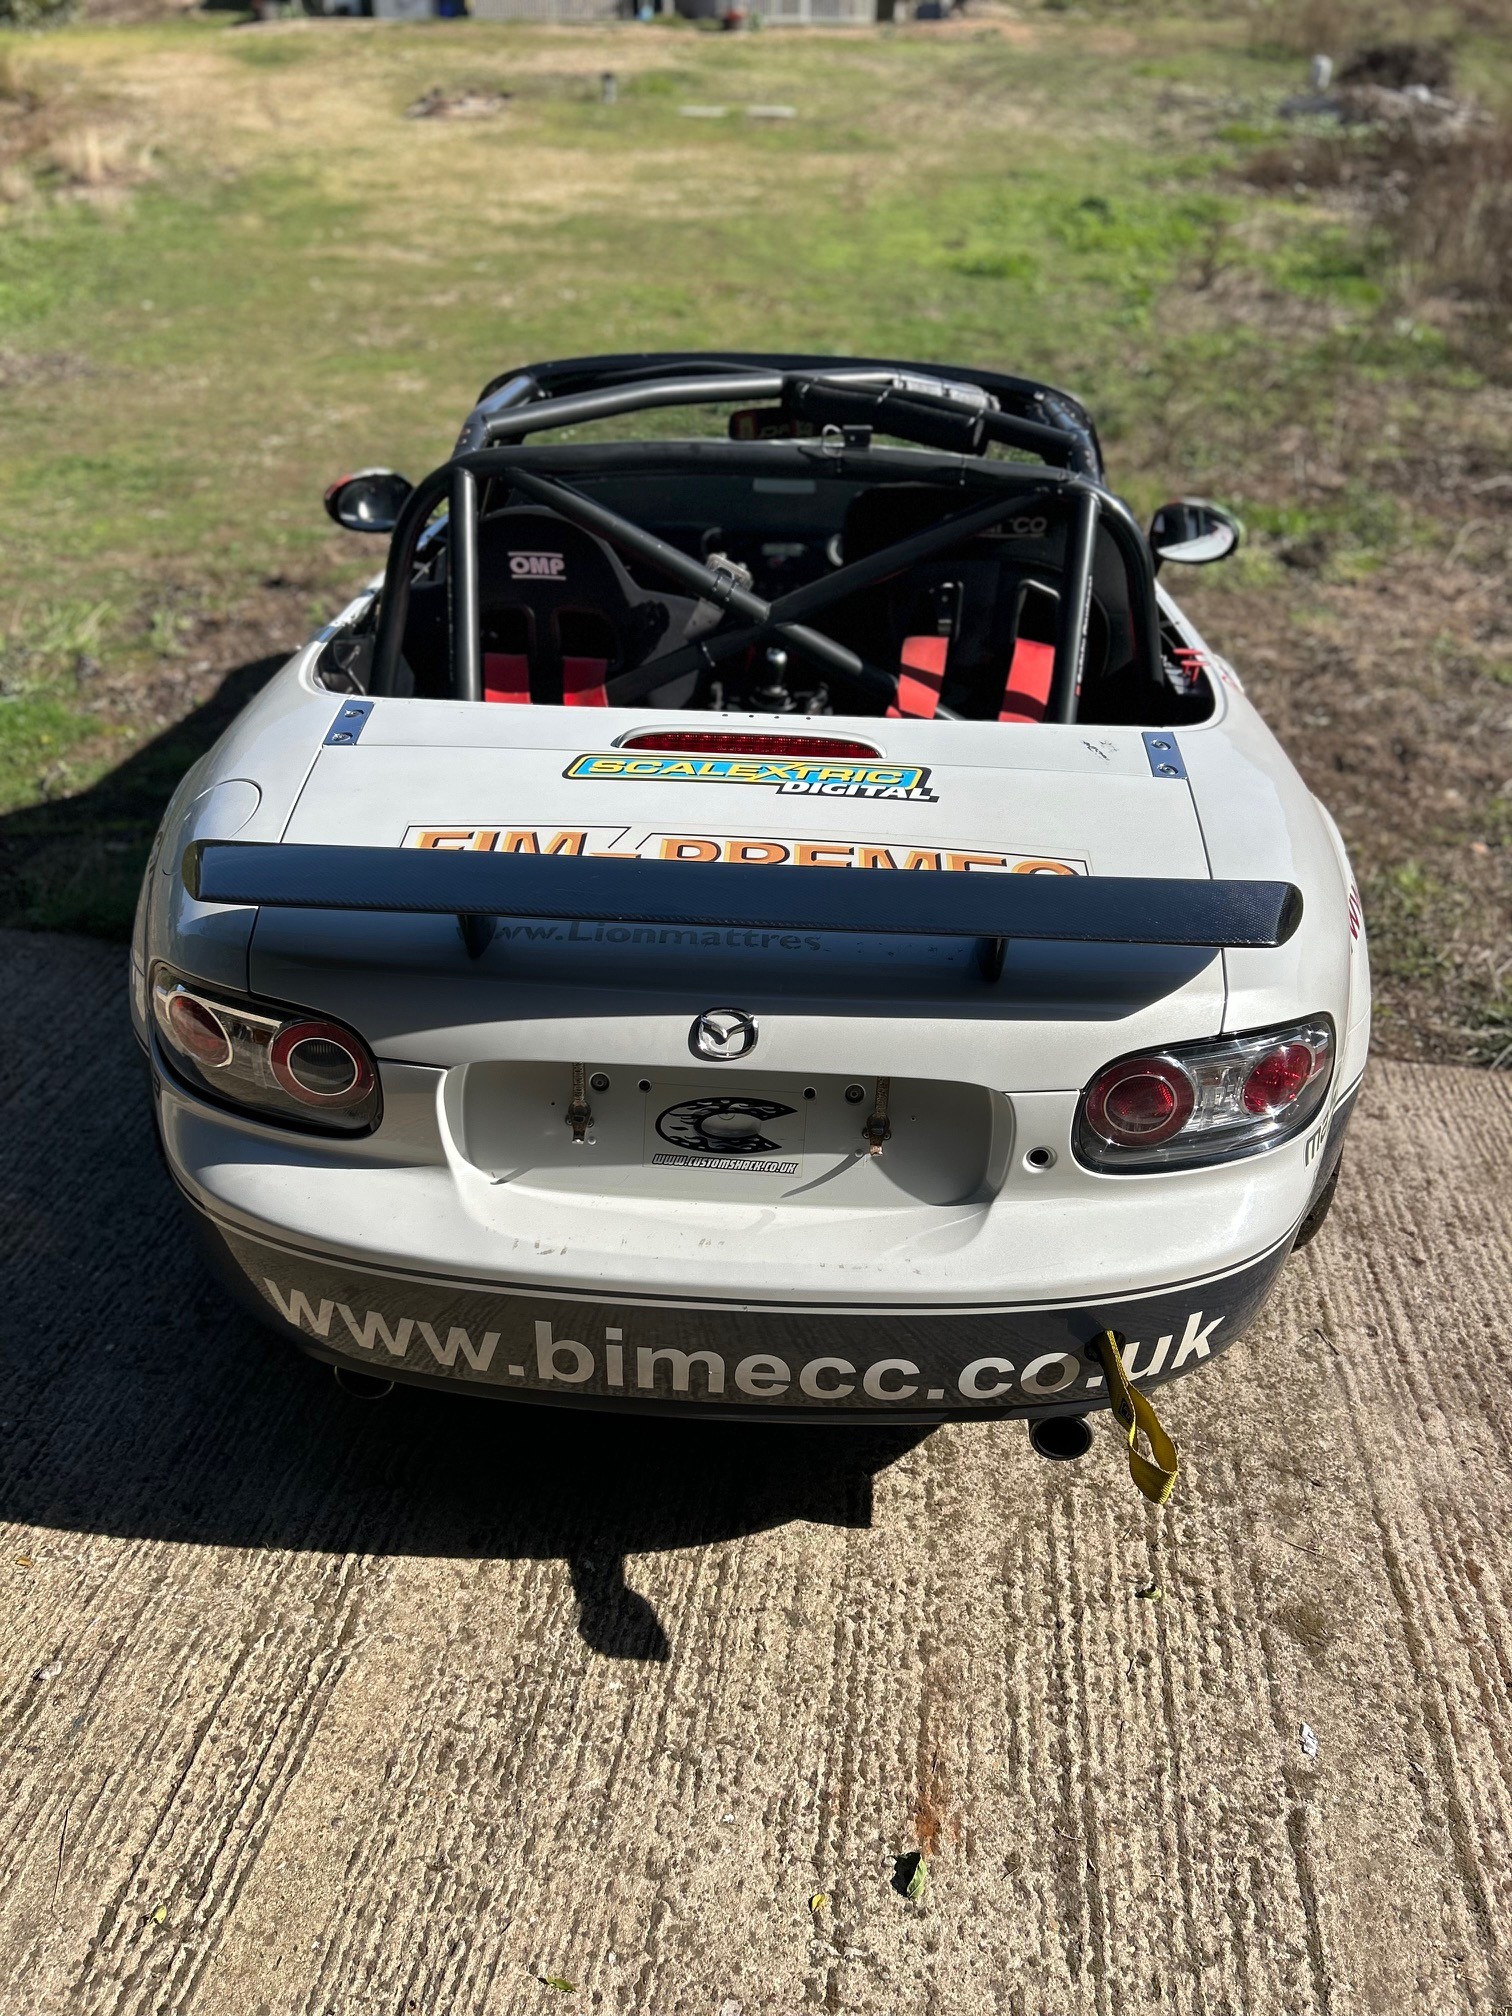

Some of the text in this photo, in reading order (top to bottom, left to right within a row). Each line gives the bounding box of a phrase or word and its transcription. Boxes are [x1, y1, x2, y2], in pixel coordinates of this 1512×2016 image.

[509, 556, 565, 575] OMP
[588, 759, 904, 785] SCALEXTRIC
[780, 781, 934, 800] DIGITAL
[652, 1153, 799, 1174] WWW.CUSTOMSHACK.CO.UK
[262, 1277, 1226, 1400] www.bimecc.co.uk
